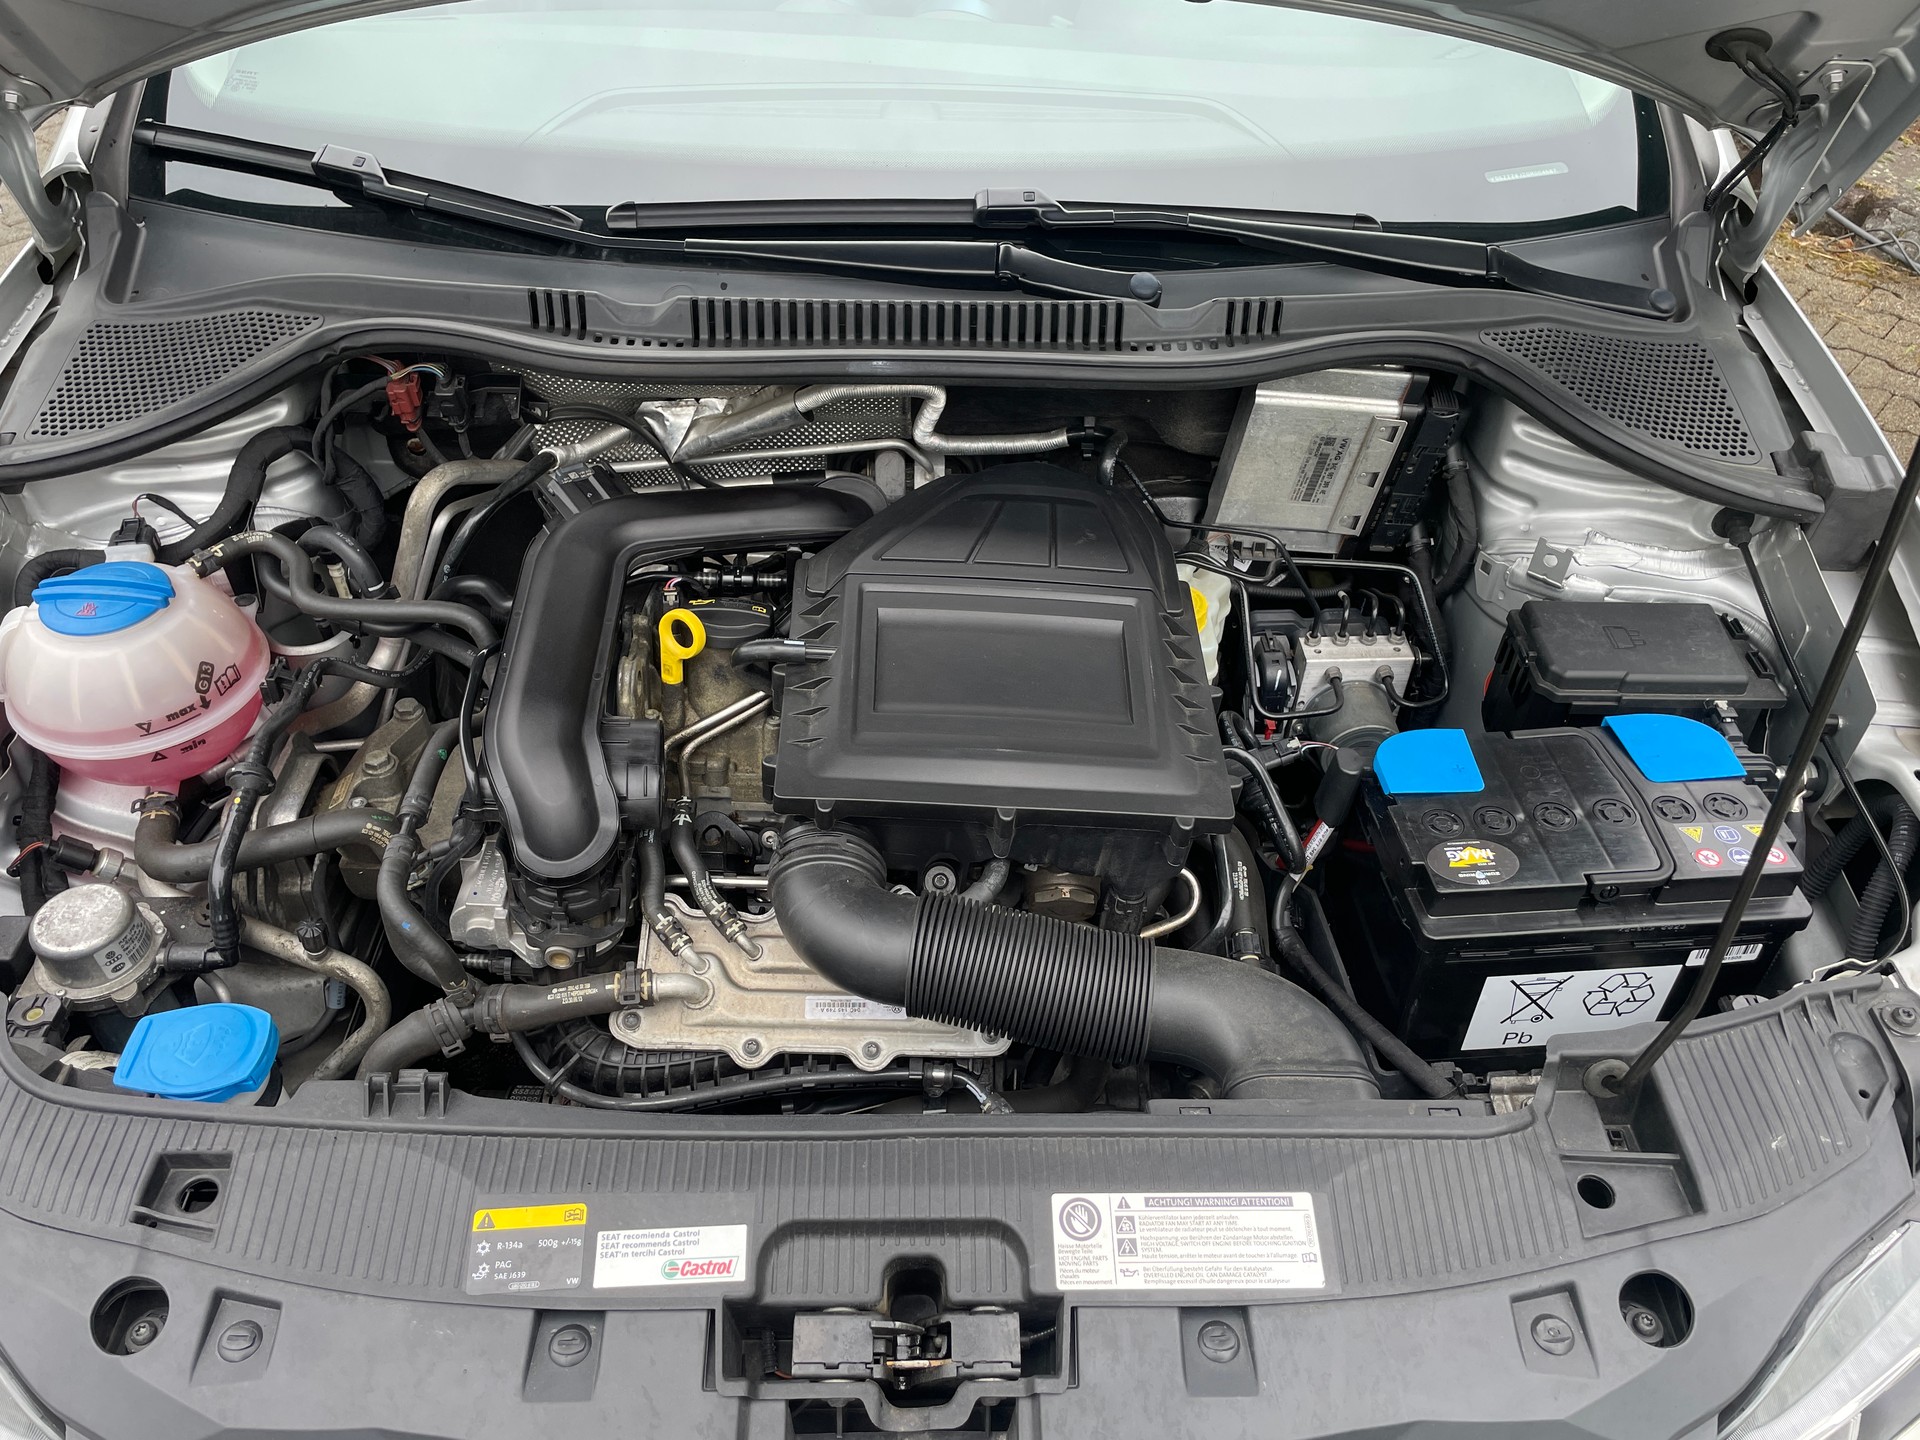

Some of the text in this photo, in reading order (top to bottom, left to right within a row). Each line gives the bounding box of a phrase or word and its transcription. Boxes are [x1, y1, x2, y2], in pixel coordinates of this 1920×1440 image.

[1339, 438, 1349, 450] VW
[1334, 450, 1343, 461] AG
[199, 664, 212, 690] G13
[165, 703, 197, 721] max
[180, 739, 206, 754] min
[1501, 1031, 1533, 1046] Pb
[1148, 1198, 1290, 1207] ACHTUNG! WARNING! ATTENTION!
[601, 1229, 701, 1241] SEAT recomienda Castrol
[497, 1240, 523, 1249] R-134a
[538, 1238, 559, 1249] 500g
[600, 1238, 700, 1250] SEAT recommends Castrol
[658, 1247, 685, 1256] Castrol
[494, 1261, 512, 1269] PAG
[679, 1258, 735, 1276] Castrol
[494, 1271, 526, 1280] SAE J639
[566, 1277, 579, 1285] VW
